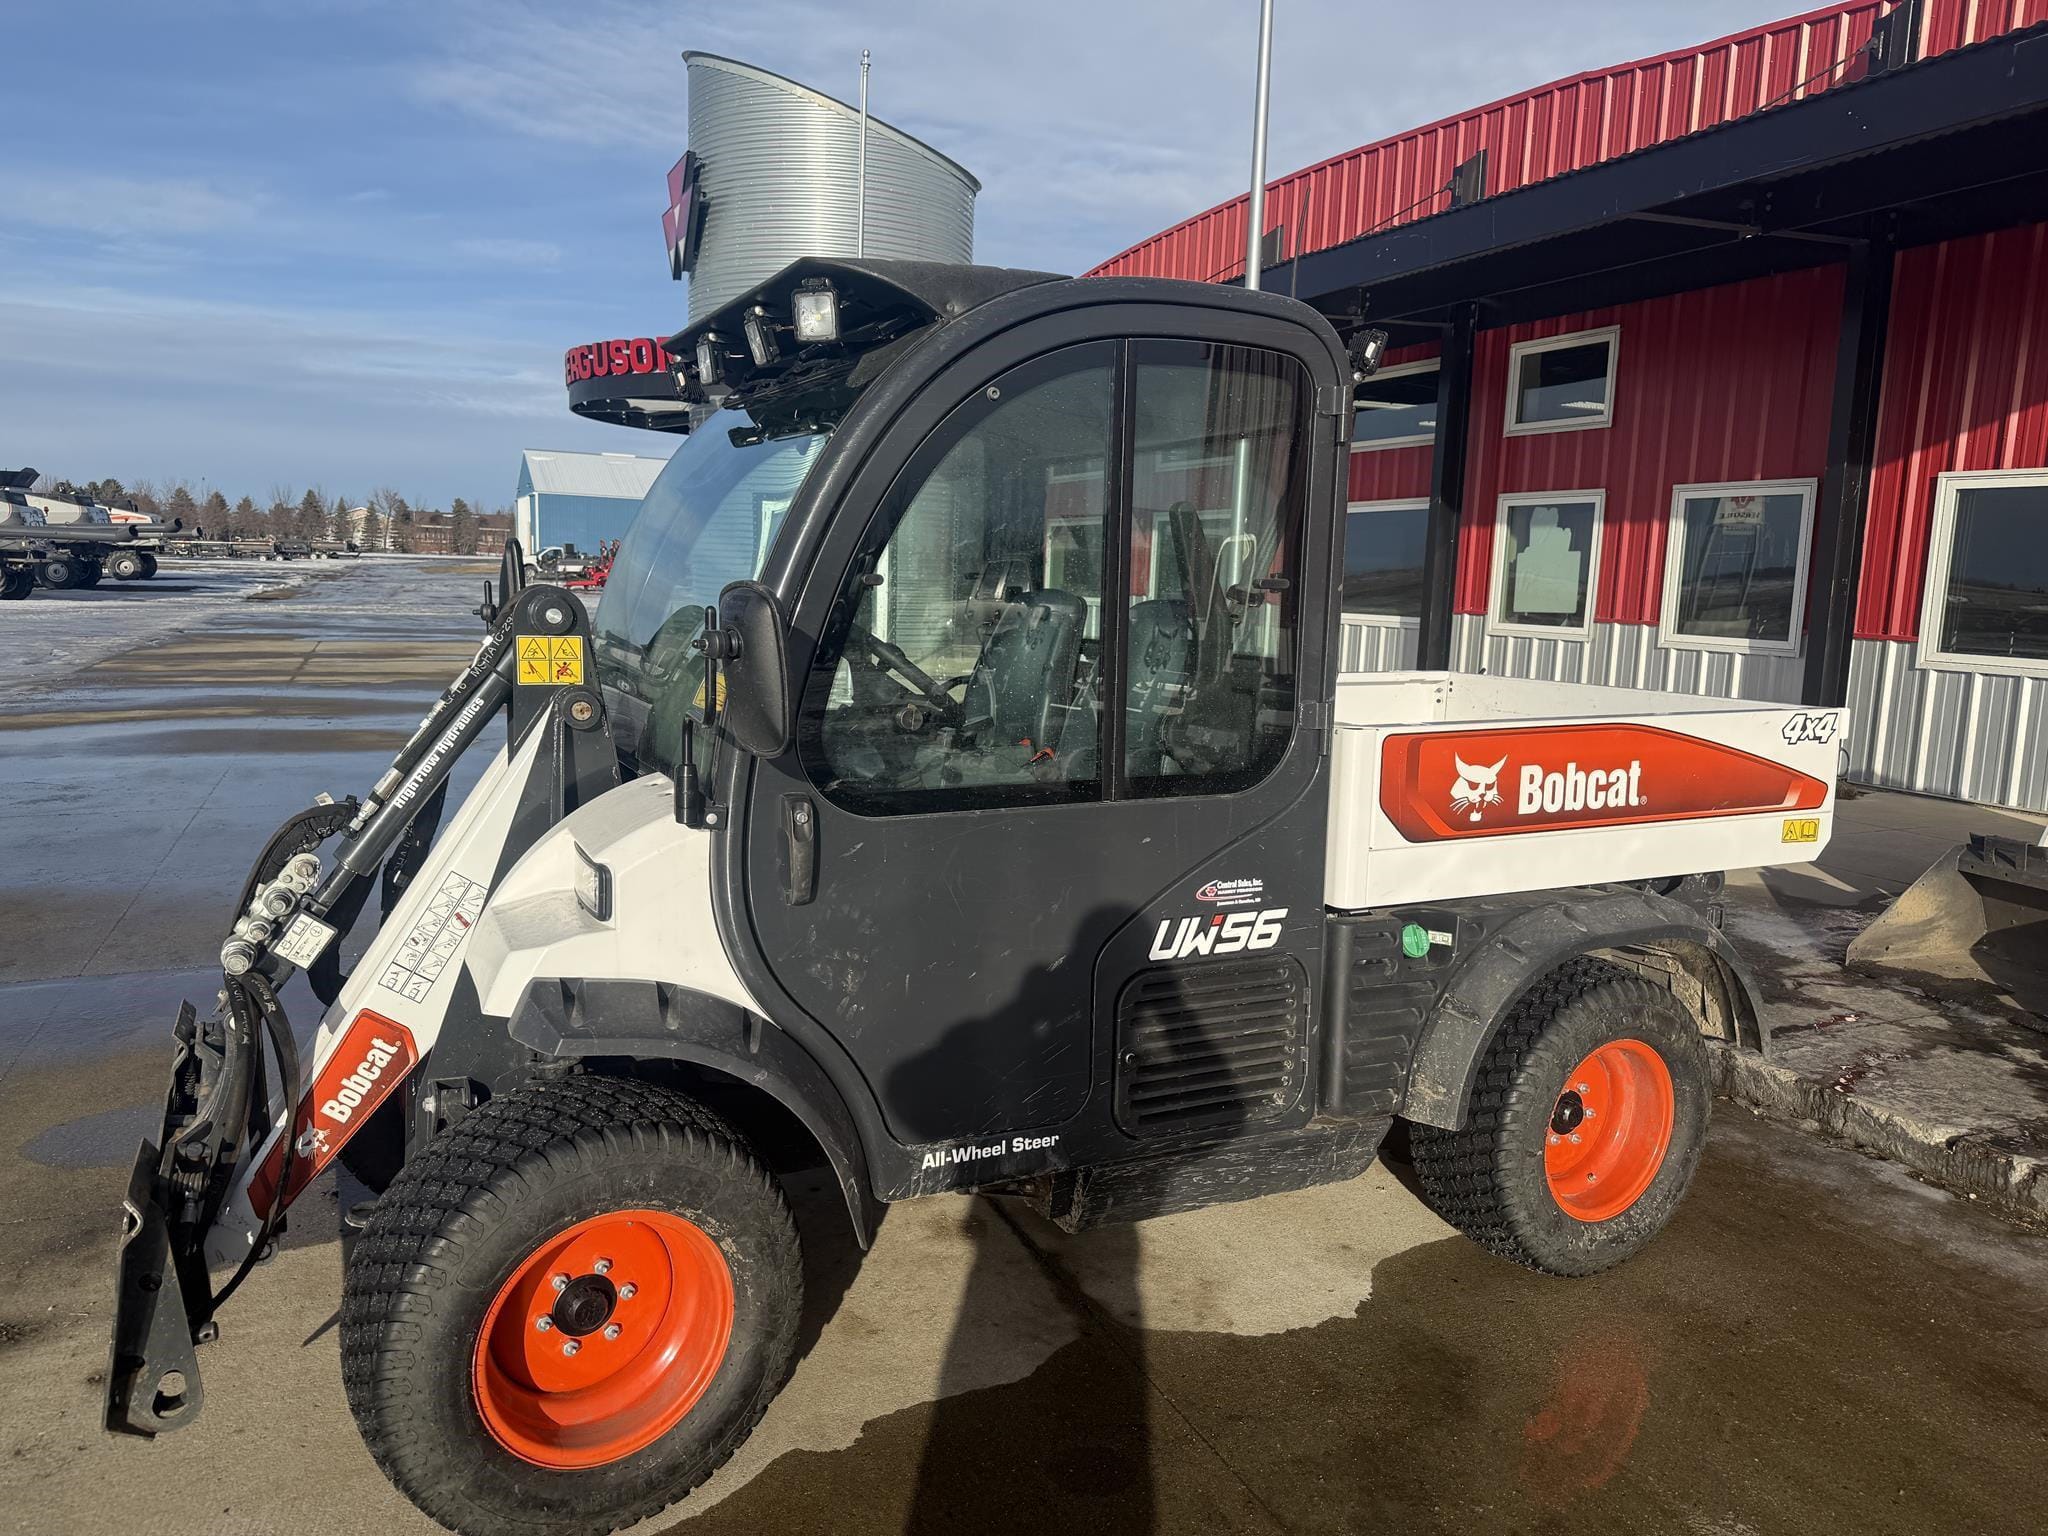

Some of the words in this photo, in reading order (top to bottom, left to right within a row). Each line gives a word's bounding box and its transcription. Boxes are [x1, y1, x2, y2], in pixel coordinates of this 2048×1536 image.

[393, 781, 419, 809] High
[415, 755, 441, 783] Flow
[436, 697, 485, 754] Hydraulics
[1782, 713, 1838, 745] 4x4
[1518, 760, 1642, 814] Bobcat
[320, 1037, 399, 1124] Bobcat
[921, 1140, 1006, 1169] All-Wheel
[1012, 1135, 1059, 1152] Steer
